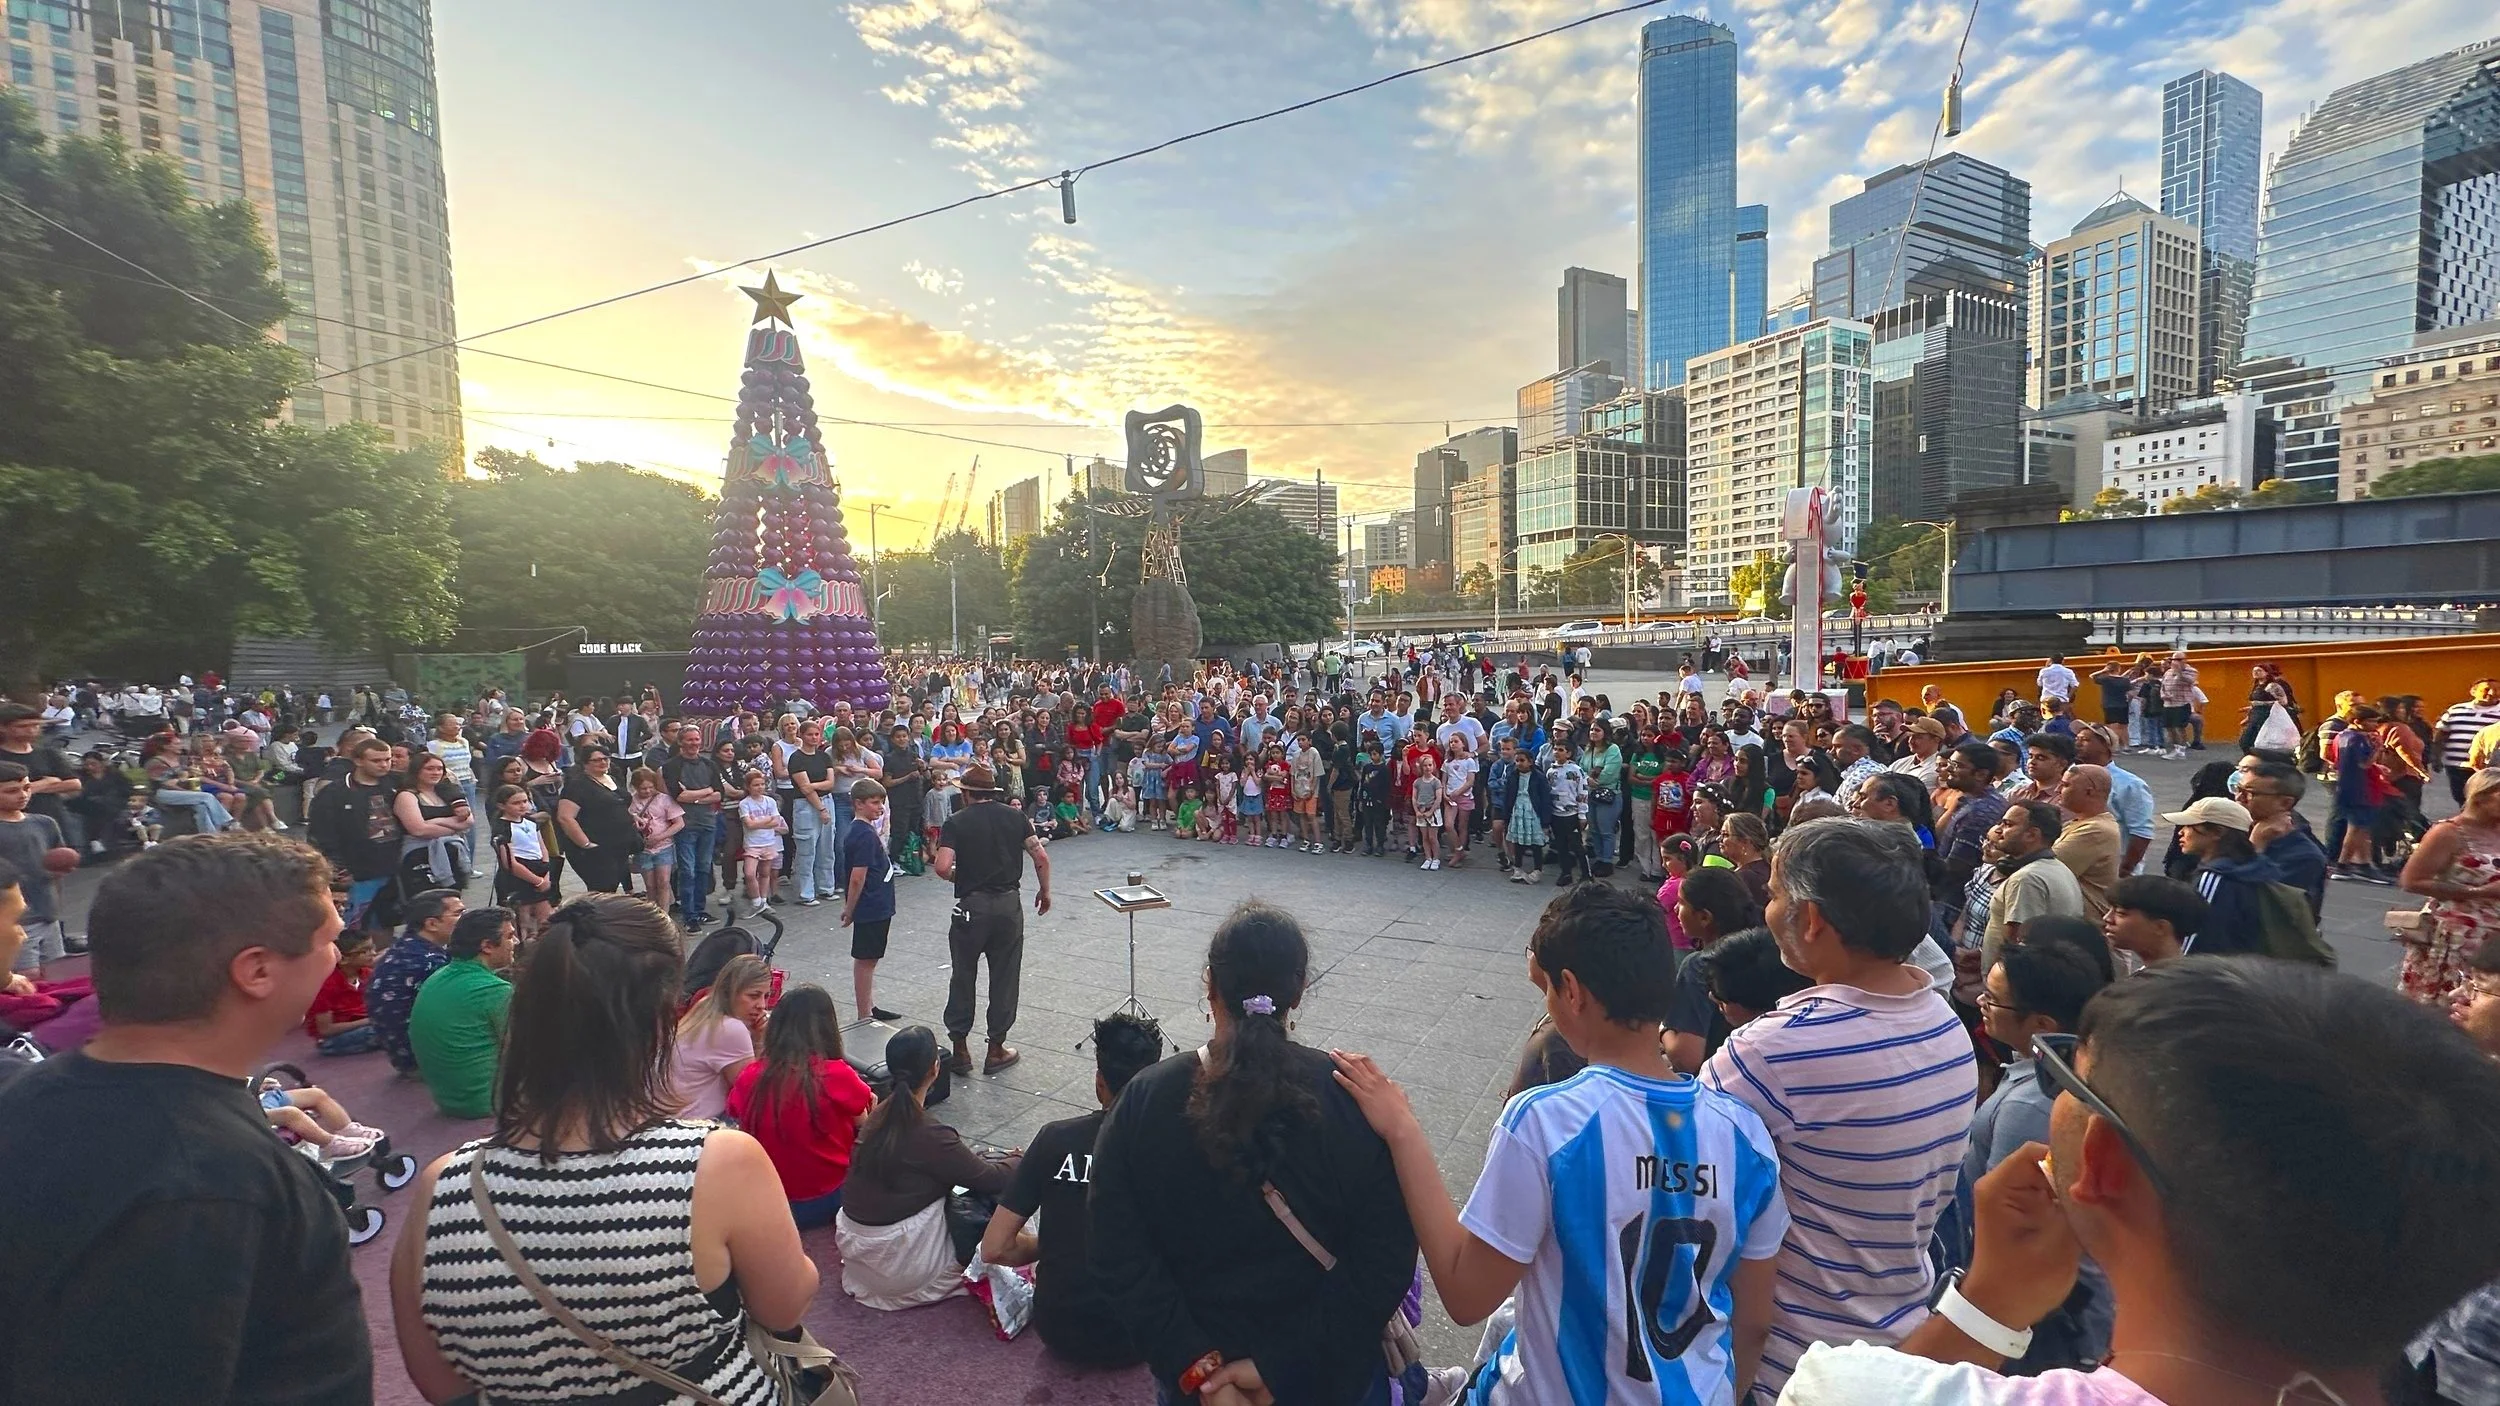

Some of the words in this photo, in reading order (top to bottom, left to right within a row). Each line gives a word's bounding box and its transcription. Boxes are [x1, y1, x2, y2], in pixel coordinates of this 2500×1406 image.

[1748, 336, 1775, 348] CLARION
[579, 643, 607, 654] CODE
[609, 643, 643, 654] BLACK
[1635, 1156, 1718, 1199] MESSI
[1619, 1210, 1718, 1383] 10
